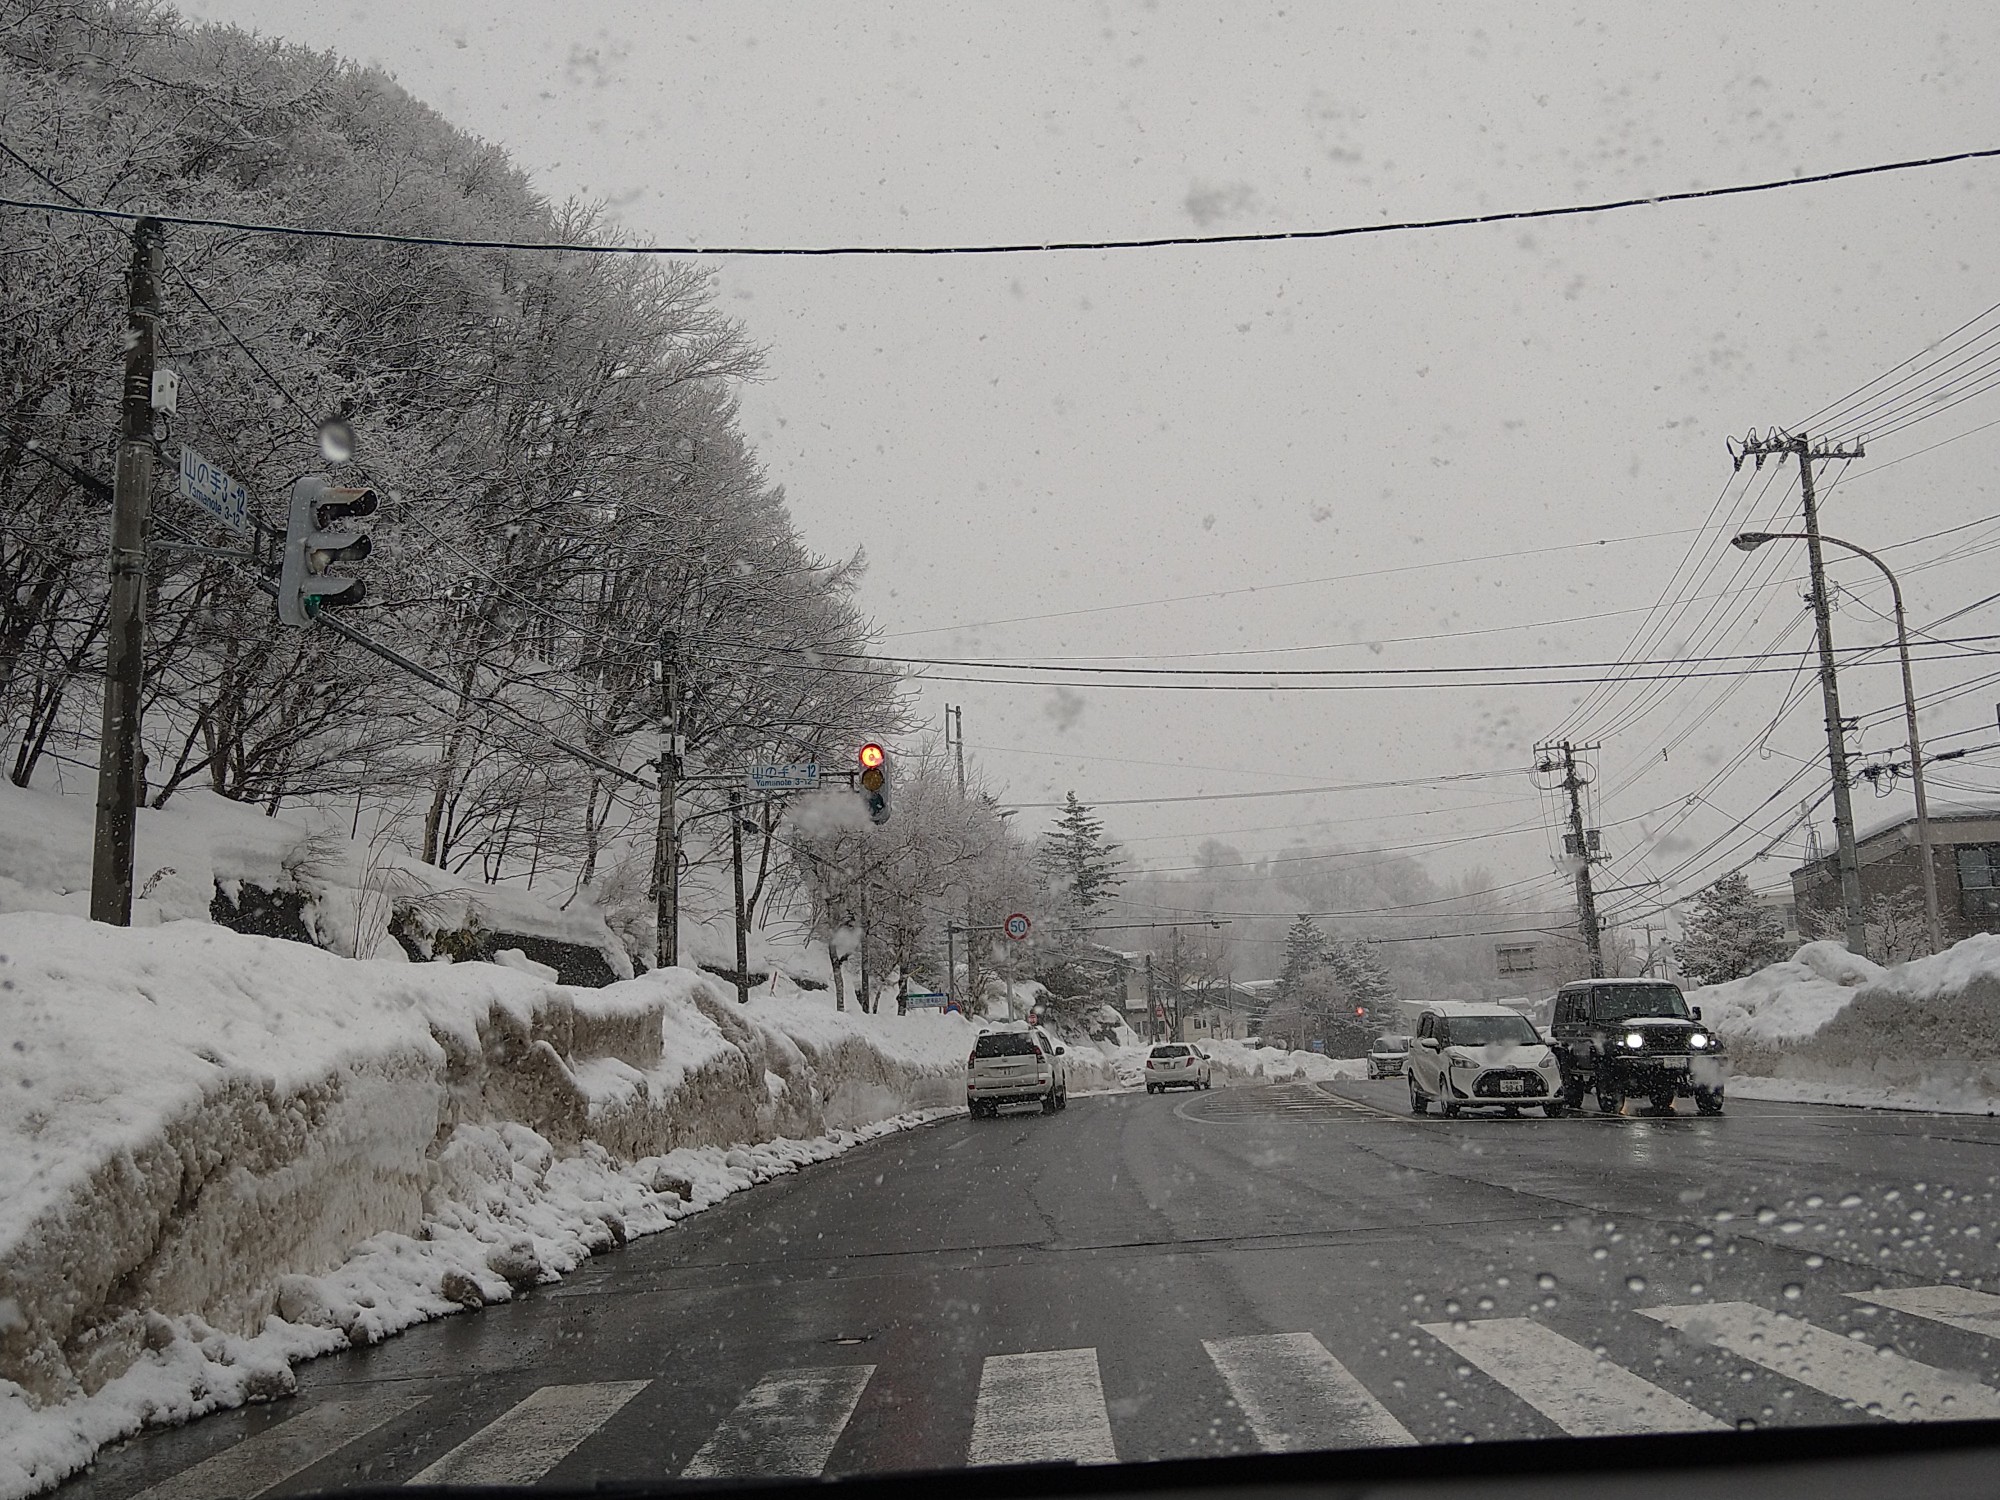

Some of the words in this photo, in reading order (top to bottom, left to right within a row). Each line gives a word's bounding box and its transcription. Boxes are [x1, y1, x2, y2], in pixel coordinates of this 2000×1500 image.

[188, 478, 223, 515] Yamanote
[224, 506, 241, 528] 3-12
[1010, 920, 1026, 933] 50
